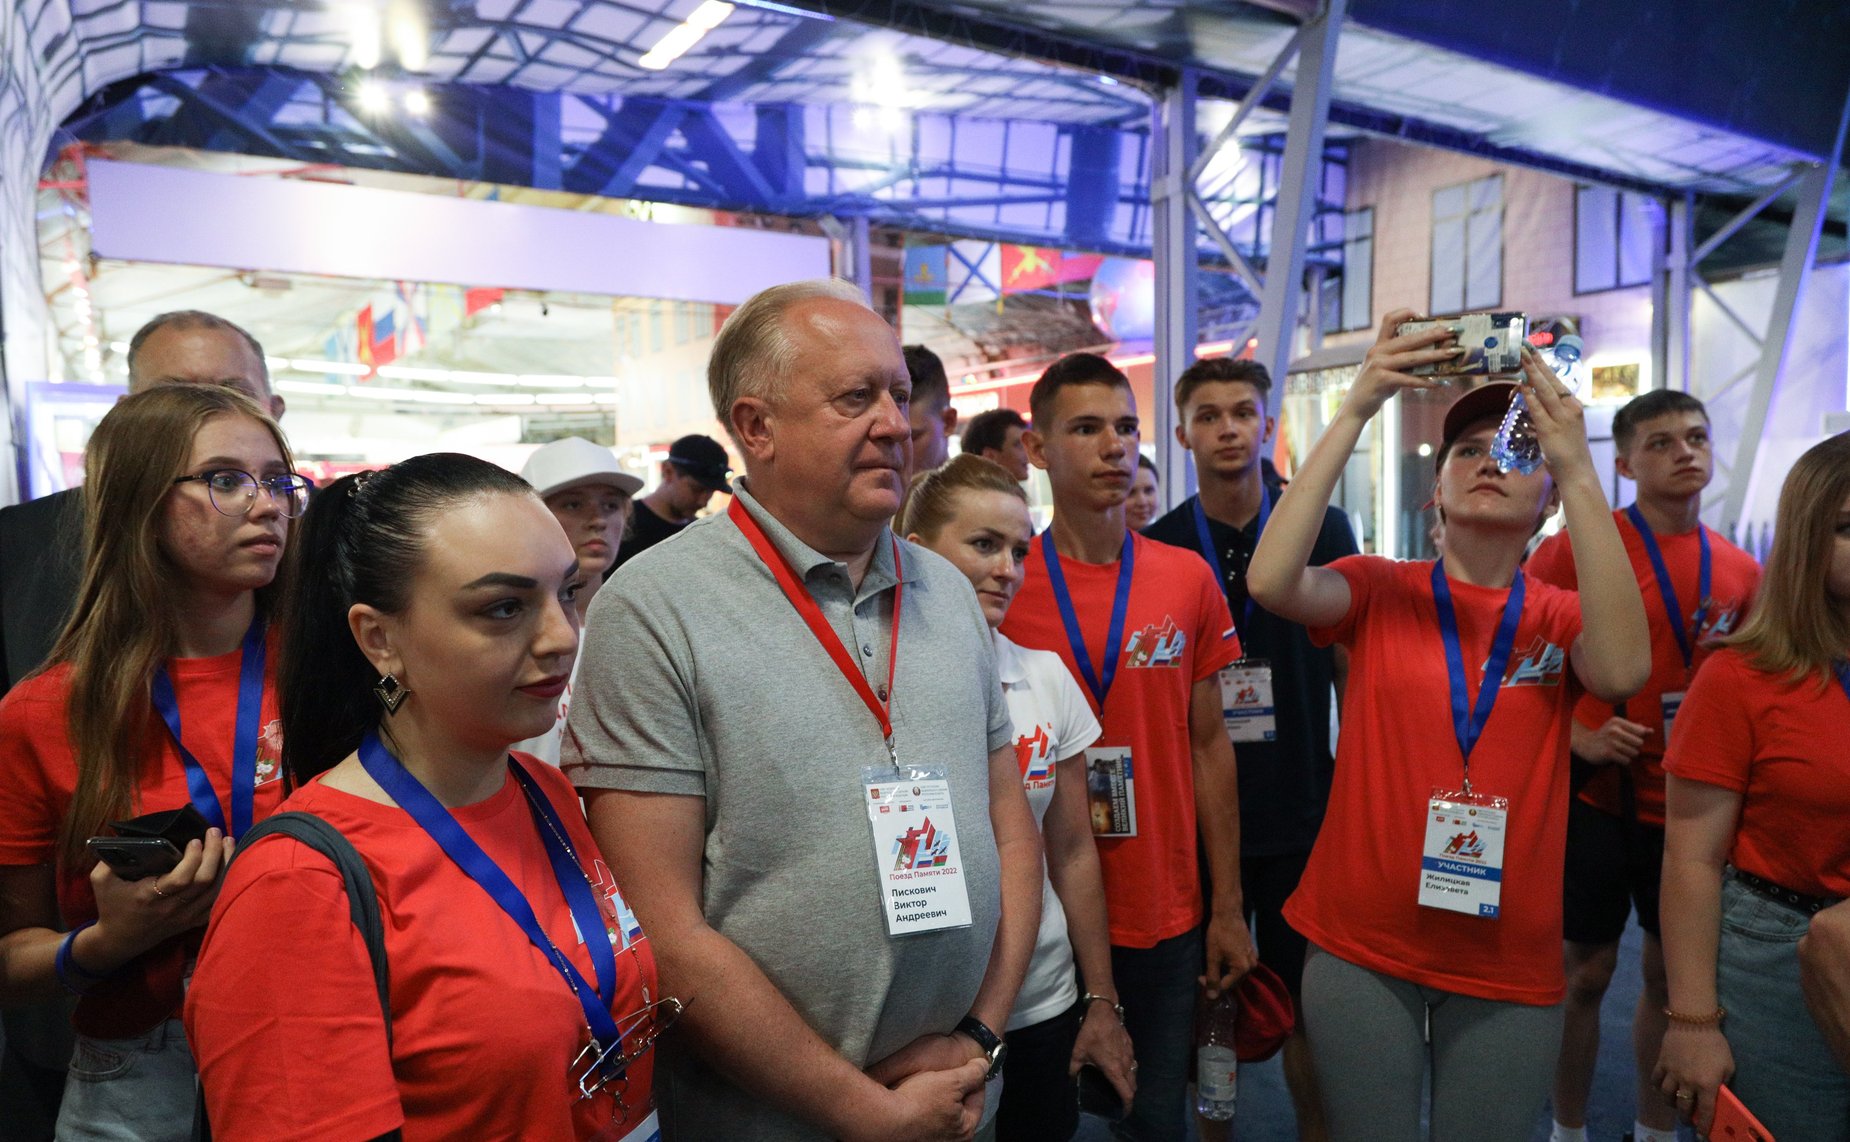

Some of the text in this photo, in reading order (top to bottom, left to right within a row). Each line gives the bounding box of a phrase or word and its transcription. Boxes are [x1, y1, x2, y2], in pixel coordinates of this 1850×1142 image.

[914, 870, 941, 878] Памяти
[942, 867, 957, 876] 2022
[1438, 861, 1487, 876] УЧАСТНИК
[1426, 874, 1471, 887] Жилицкая
[891, 886, 937, 897] Пискович
[893, 899, 928, 910] Виктор
[1483, 905, 1494, 914] 2.1
[896, 910, 947, 922] Андреевич
